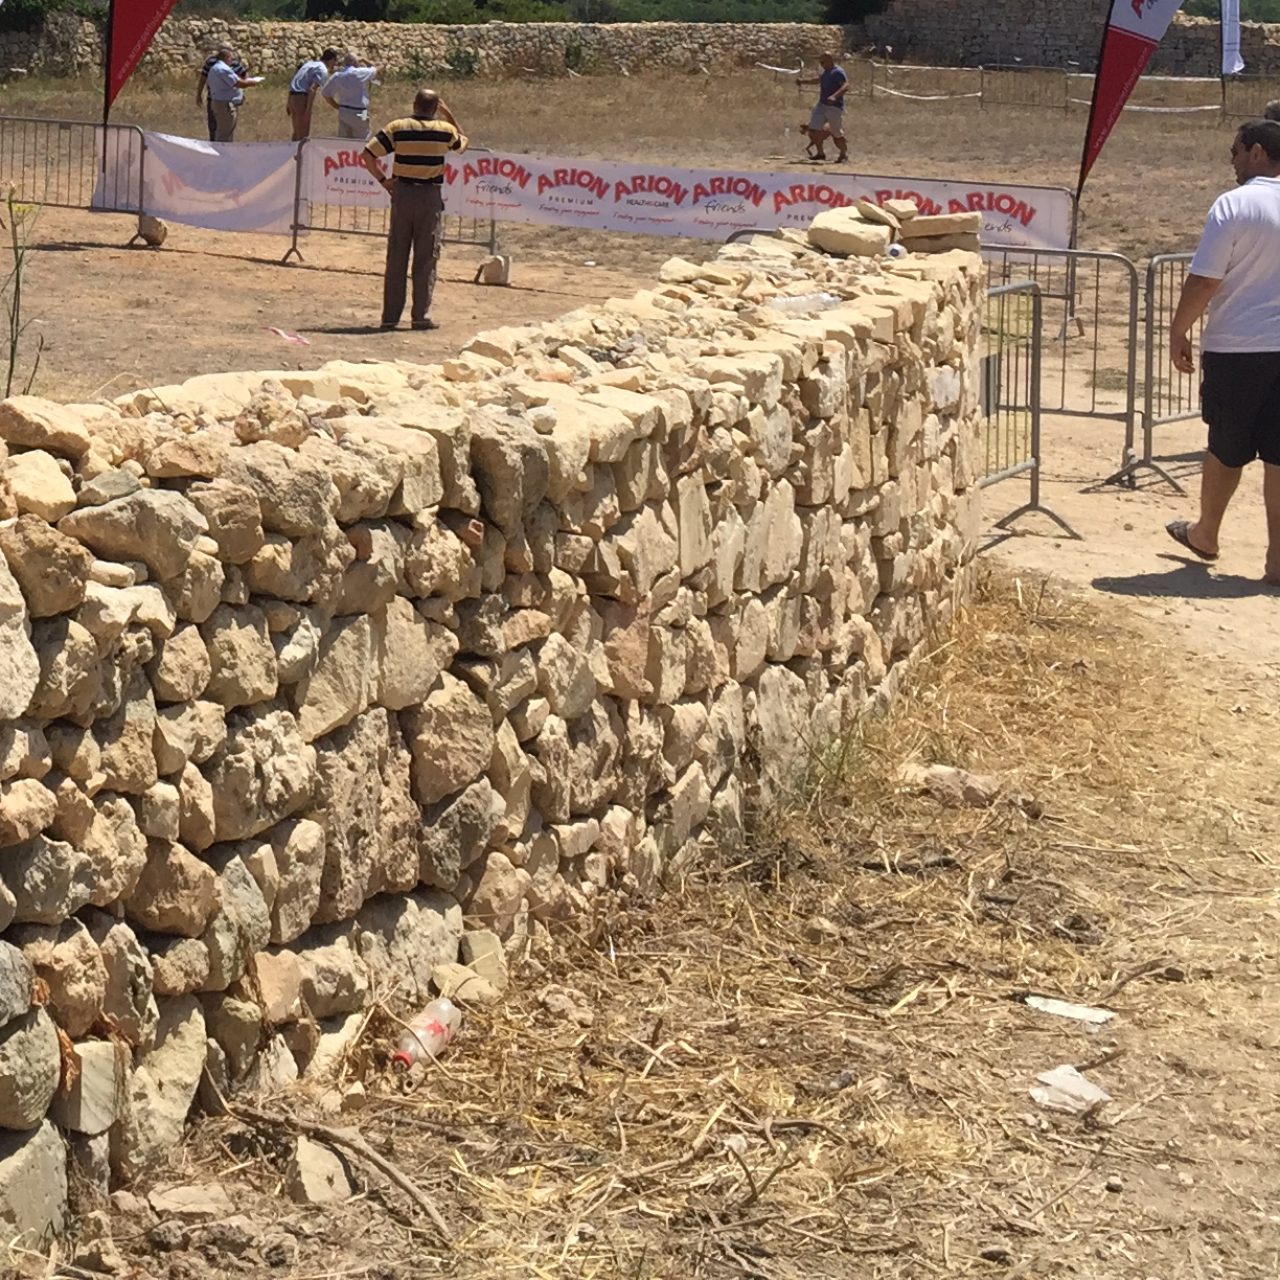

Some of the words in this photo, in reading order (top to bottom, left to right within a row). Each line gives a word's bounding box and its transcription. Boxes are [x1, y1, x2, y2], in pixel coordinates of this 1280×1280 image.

[463, 158, 532, 189] ARION
[537, 168, 610, 199] ARION
[614, 175, 689, 206] ARION
[692, 176, 767, 207] ARION
[948, 191, 1036, 226] ARION
